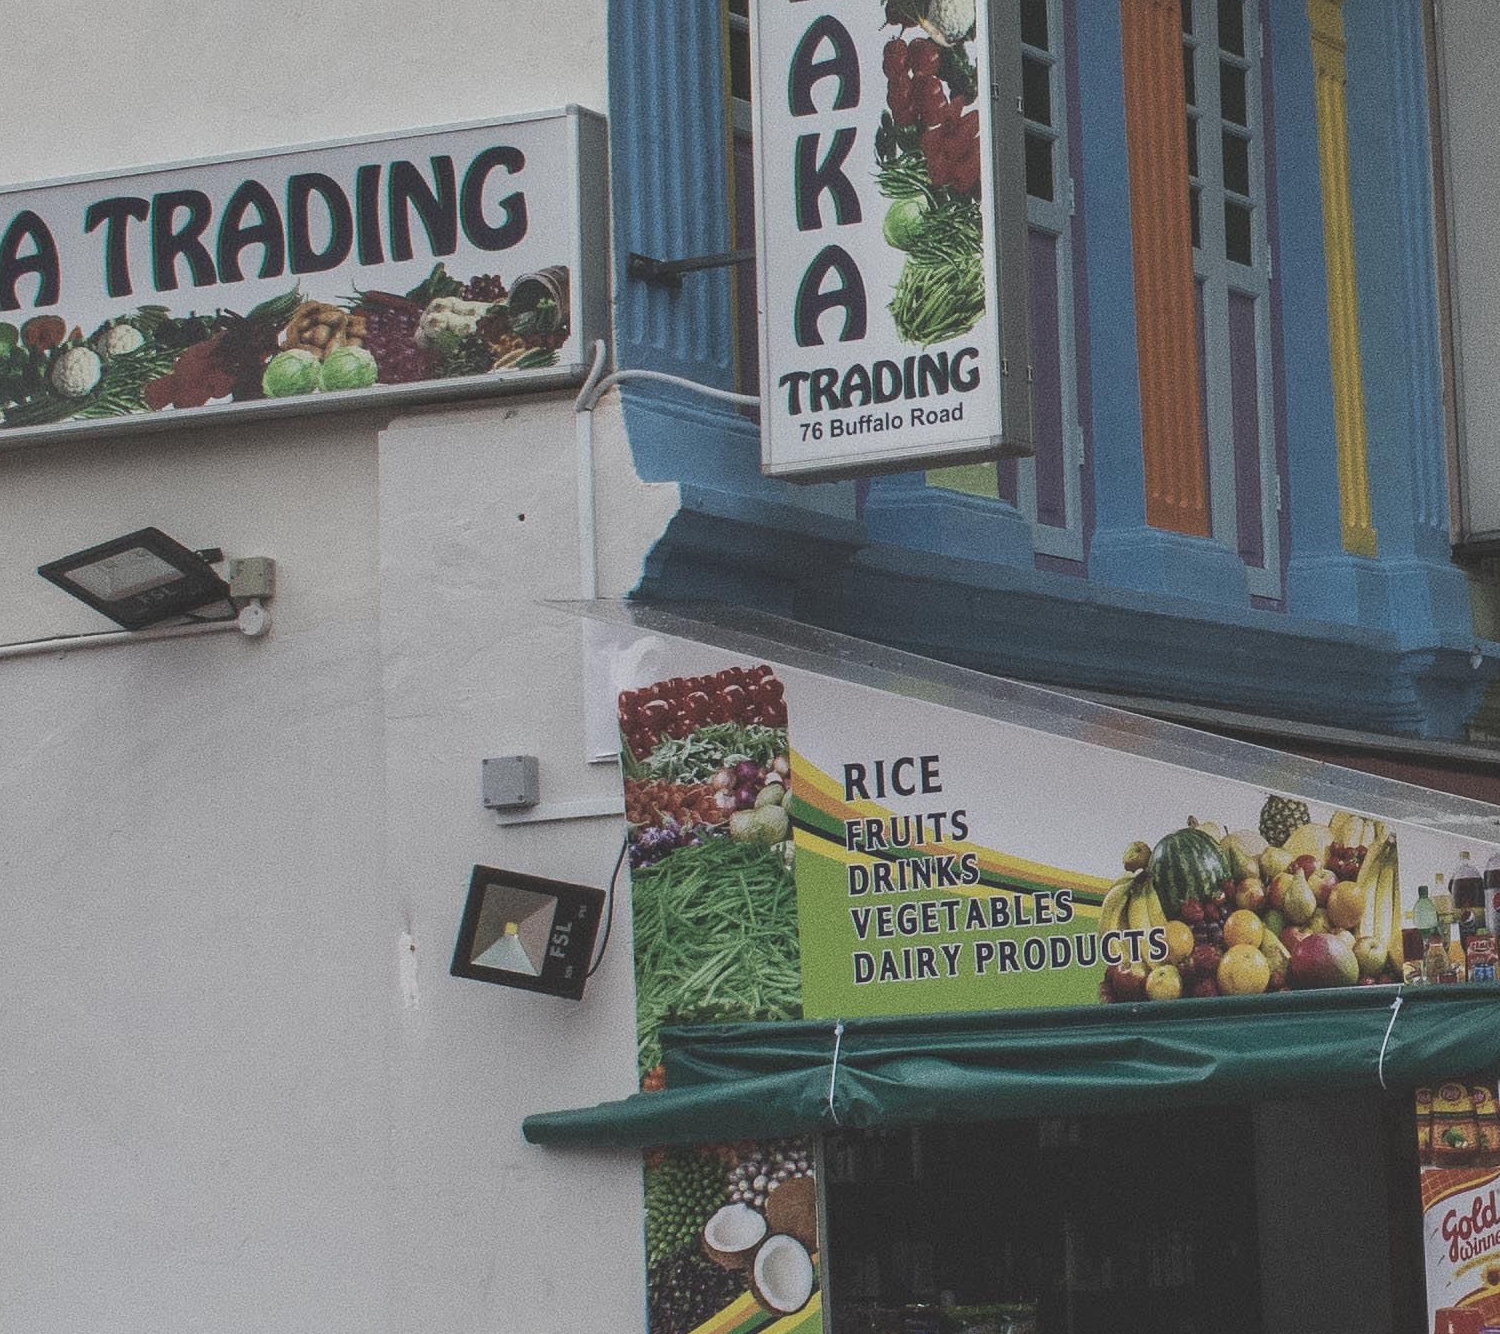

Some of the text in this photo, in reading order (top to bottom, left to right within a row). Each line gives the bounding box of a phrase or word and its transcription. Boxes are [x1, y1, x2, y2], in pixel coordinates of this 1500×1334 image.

[86, 146, 528, 298] TRADING
[778, 347, 981, 416] TRADING
[799, 402, 964, 442] 76 Buffalo Road
[845, 755, 942, 801] RICE
[846, 809, 969, 852] FRUITS
[849, 852, 981, 897] DRINKS
[851, 889, 1075, 940] VEGETABLES
[852, 927, 1168, 986] DAIRY PRODUCTS
